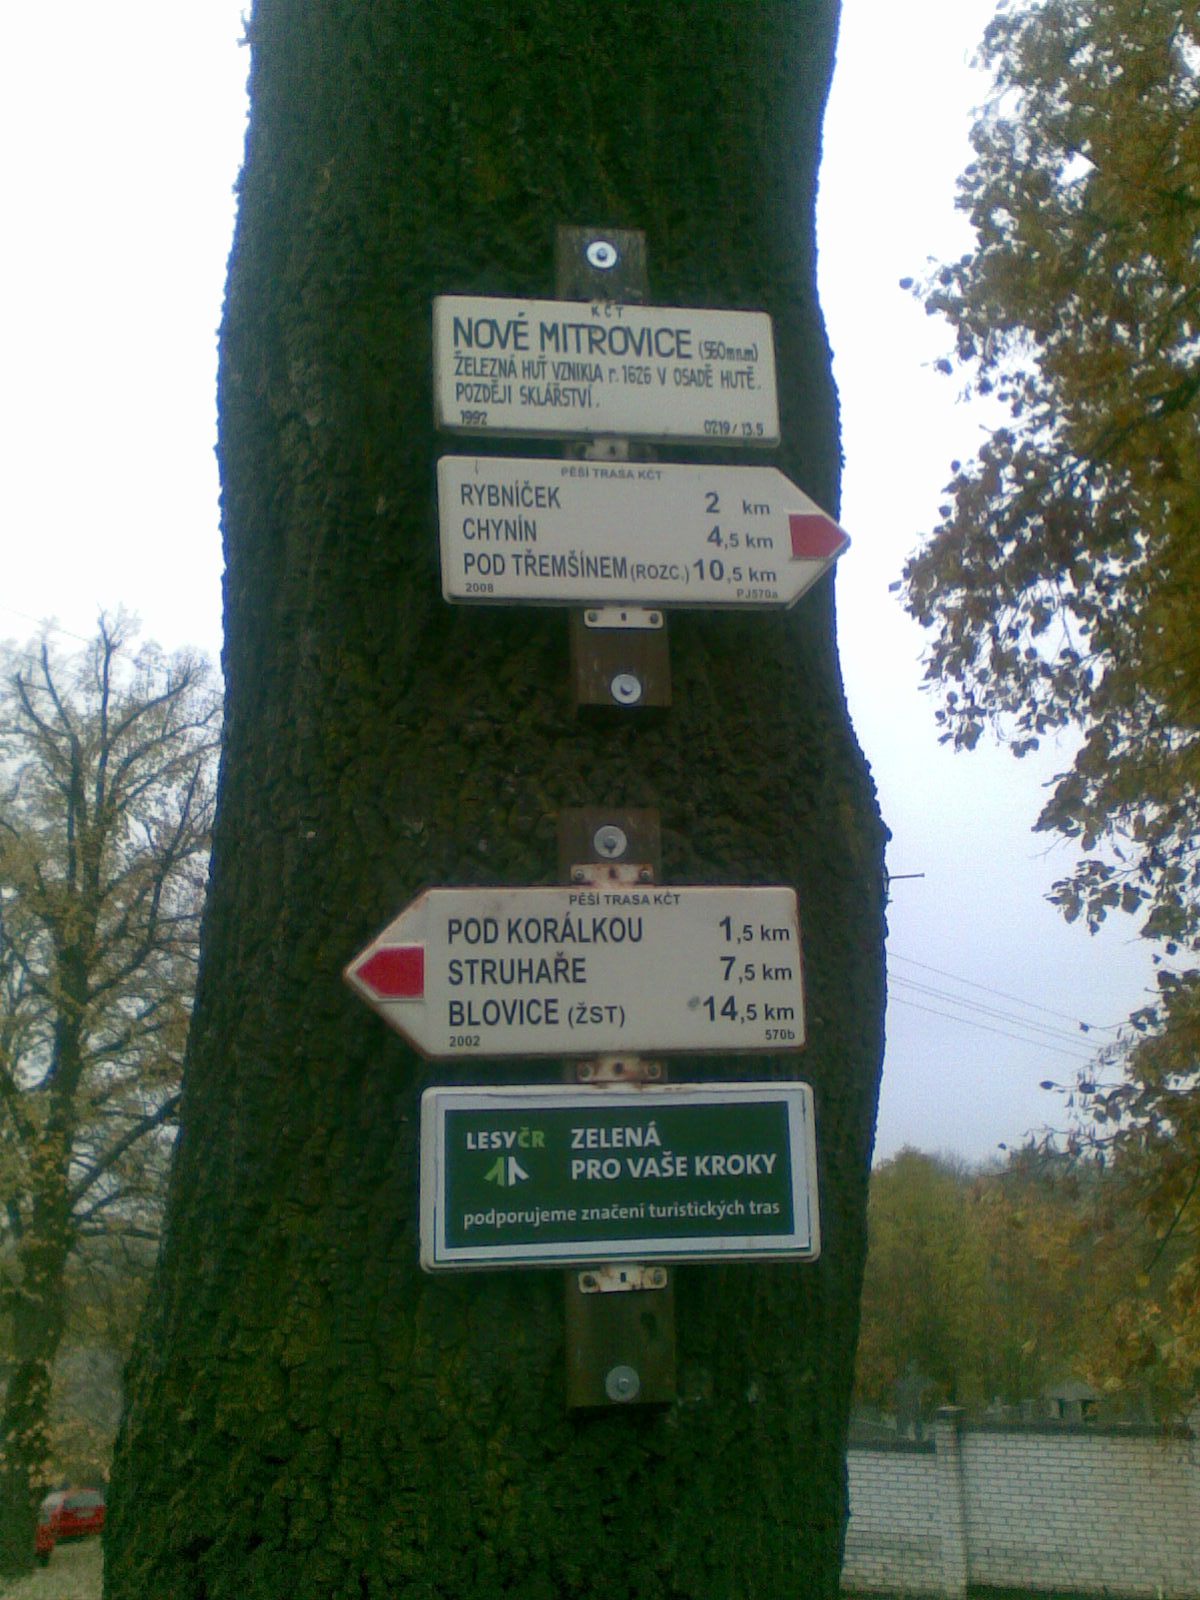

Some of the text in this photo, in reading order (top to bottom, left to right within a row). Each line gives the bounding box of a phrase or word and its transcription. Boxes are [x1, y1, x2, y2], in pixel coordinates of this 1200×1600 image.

[453, 312, 529, 351] NOVÉ
[539, 322, 692, 360] MITROVICE
[454, 350, 518, 379] ŽELEZNÁ
[552, 360, 604, 383] VZNIKLA
[673, 363, 713, 388] OSADĚ
[455, 379, 512, 405] POZDĚJI
[460, 409, 488, 426] 1992
[593, 467, 634, 480] TRASA
[460, 481, 771, 515] RYBNÍČEK 2 km
[462, 516, 774, 550] CHYNÍN 4,5 km
[463, 553, 506, 577] POD
[513, 549, 627, 580] TŘEMŠÍNEM
[748, 566, 777, 582] km
[465, 582, 494, 594] 2008
[604, 894, 649, 906] TRASA
[654, 892, 680, 906] KČT
[448, 913, 790, 944] POD KORÁLKOU 1,5 km
[448, 952, 793, 985] STRUHAŘE 7,5 km
[449, 995, 795, 1028] BLOVICE (ŽST) 14,5 km
[449, 1036, 480, 1047] 2002
[765, 1029, 795, 1041] 570b
[571, 1120, 661, 1150] ZELENÁ
[571, 1151, 777, 1180] PRO VAŠE KROKY
[463, 1198, 781, 1231] podporujeme značení turistických tras
